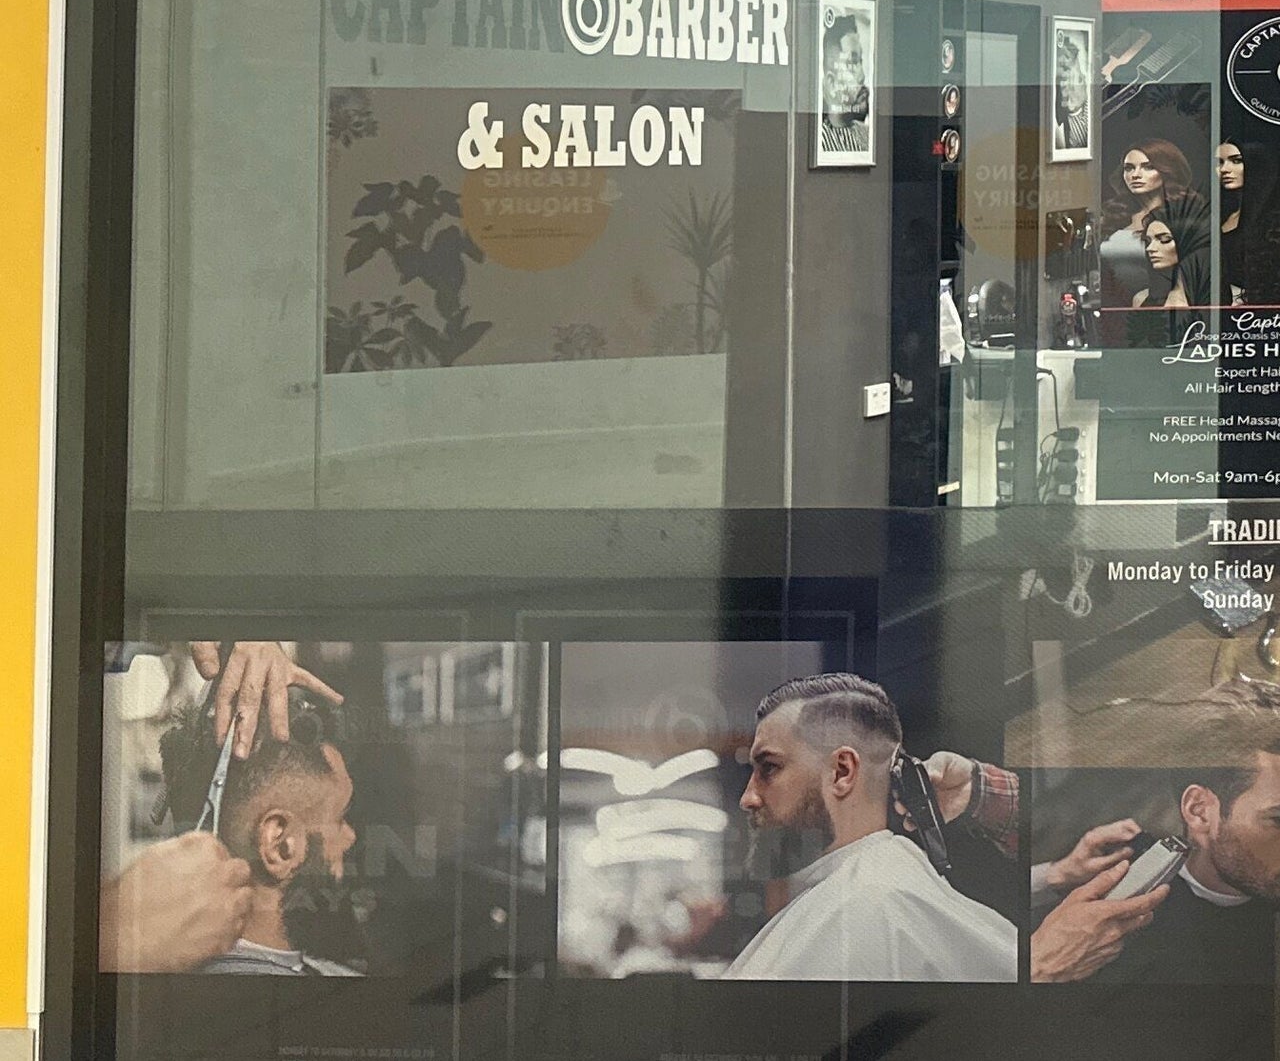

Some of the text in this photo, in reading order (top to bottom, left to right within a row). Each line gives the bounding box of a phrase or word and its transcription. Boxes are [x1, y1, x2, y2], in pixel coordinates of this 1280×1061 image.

[1250, 97, 1280, 118] QUALITY
[457, 101, 705, 170] & SALON
[1194, 331, 1219, 342] Shop
[1221, 331, 1241, 340] 22A
[1242, 331, 1268, 340] Oasis
[1214, 367, 1257, 379] Expert
[1185, 382, 1202, 393] All
[1205, 382, 1234, 393] Hair
[1163, 416, 1197, 426] FREE
[1200, 415, 1234, 426] Head
[1150, 432, 1168, 443] No
[1171, 430, 1263, 444] Appointments
[1153, 471, 1221, 485] Mon-Sat
[1107, 561, 1183, 584] Monday
[1189, 563, 1209, 580] to
[1214, 560, 1275, 582] Friday
[1203, 589, 1275, 612] Sunday
